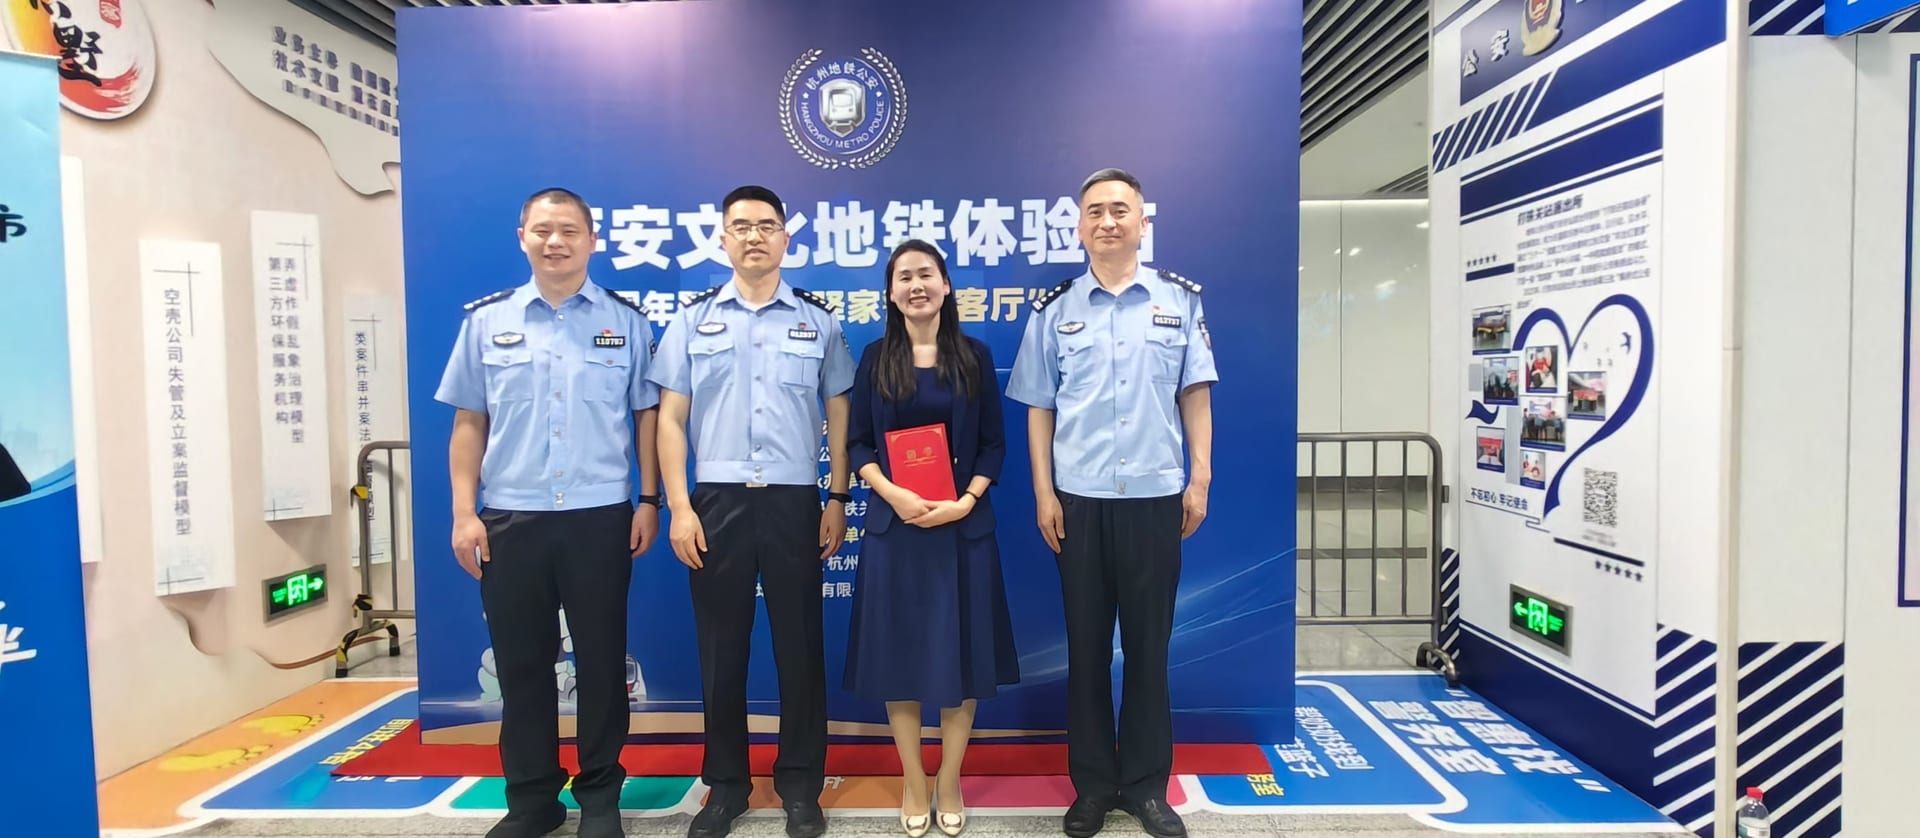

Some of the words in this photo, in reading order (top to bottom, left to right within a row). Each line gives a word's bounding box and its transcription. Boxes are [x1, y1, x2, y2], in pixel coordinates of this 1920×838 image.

[805, 61, 879, 91] 杭州地铁公安
[801, 102, 834, 147] HANGZHOU
[834, 132, 870, 149] METRO
[868, 99, 885, 134] POLICE
[268, 257, 289, 425] 第三方环保服务机构
[163, 288, 192, 536] 空壳公司失管及立案监督模型
[822, 582, 855, 598] 有限
[1368, 700, 1507, 775] 警务室
